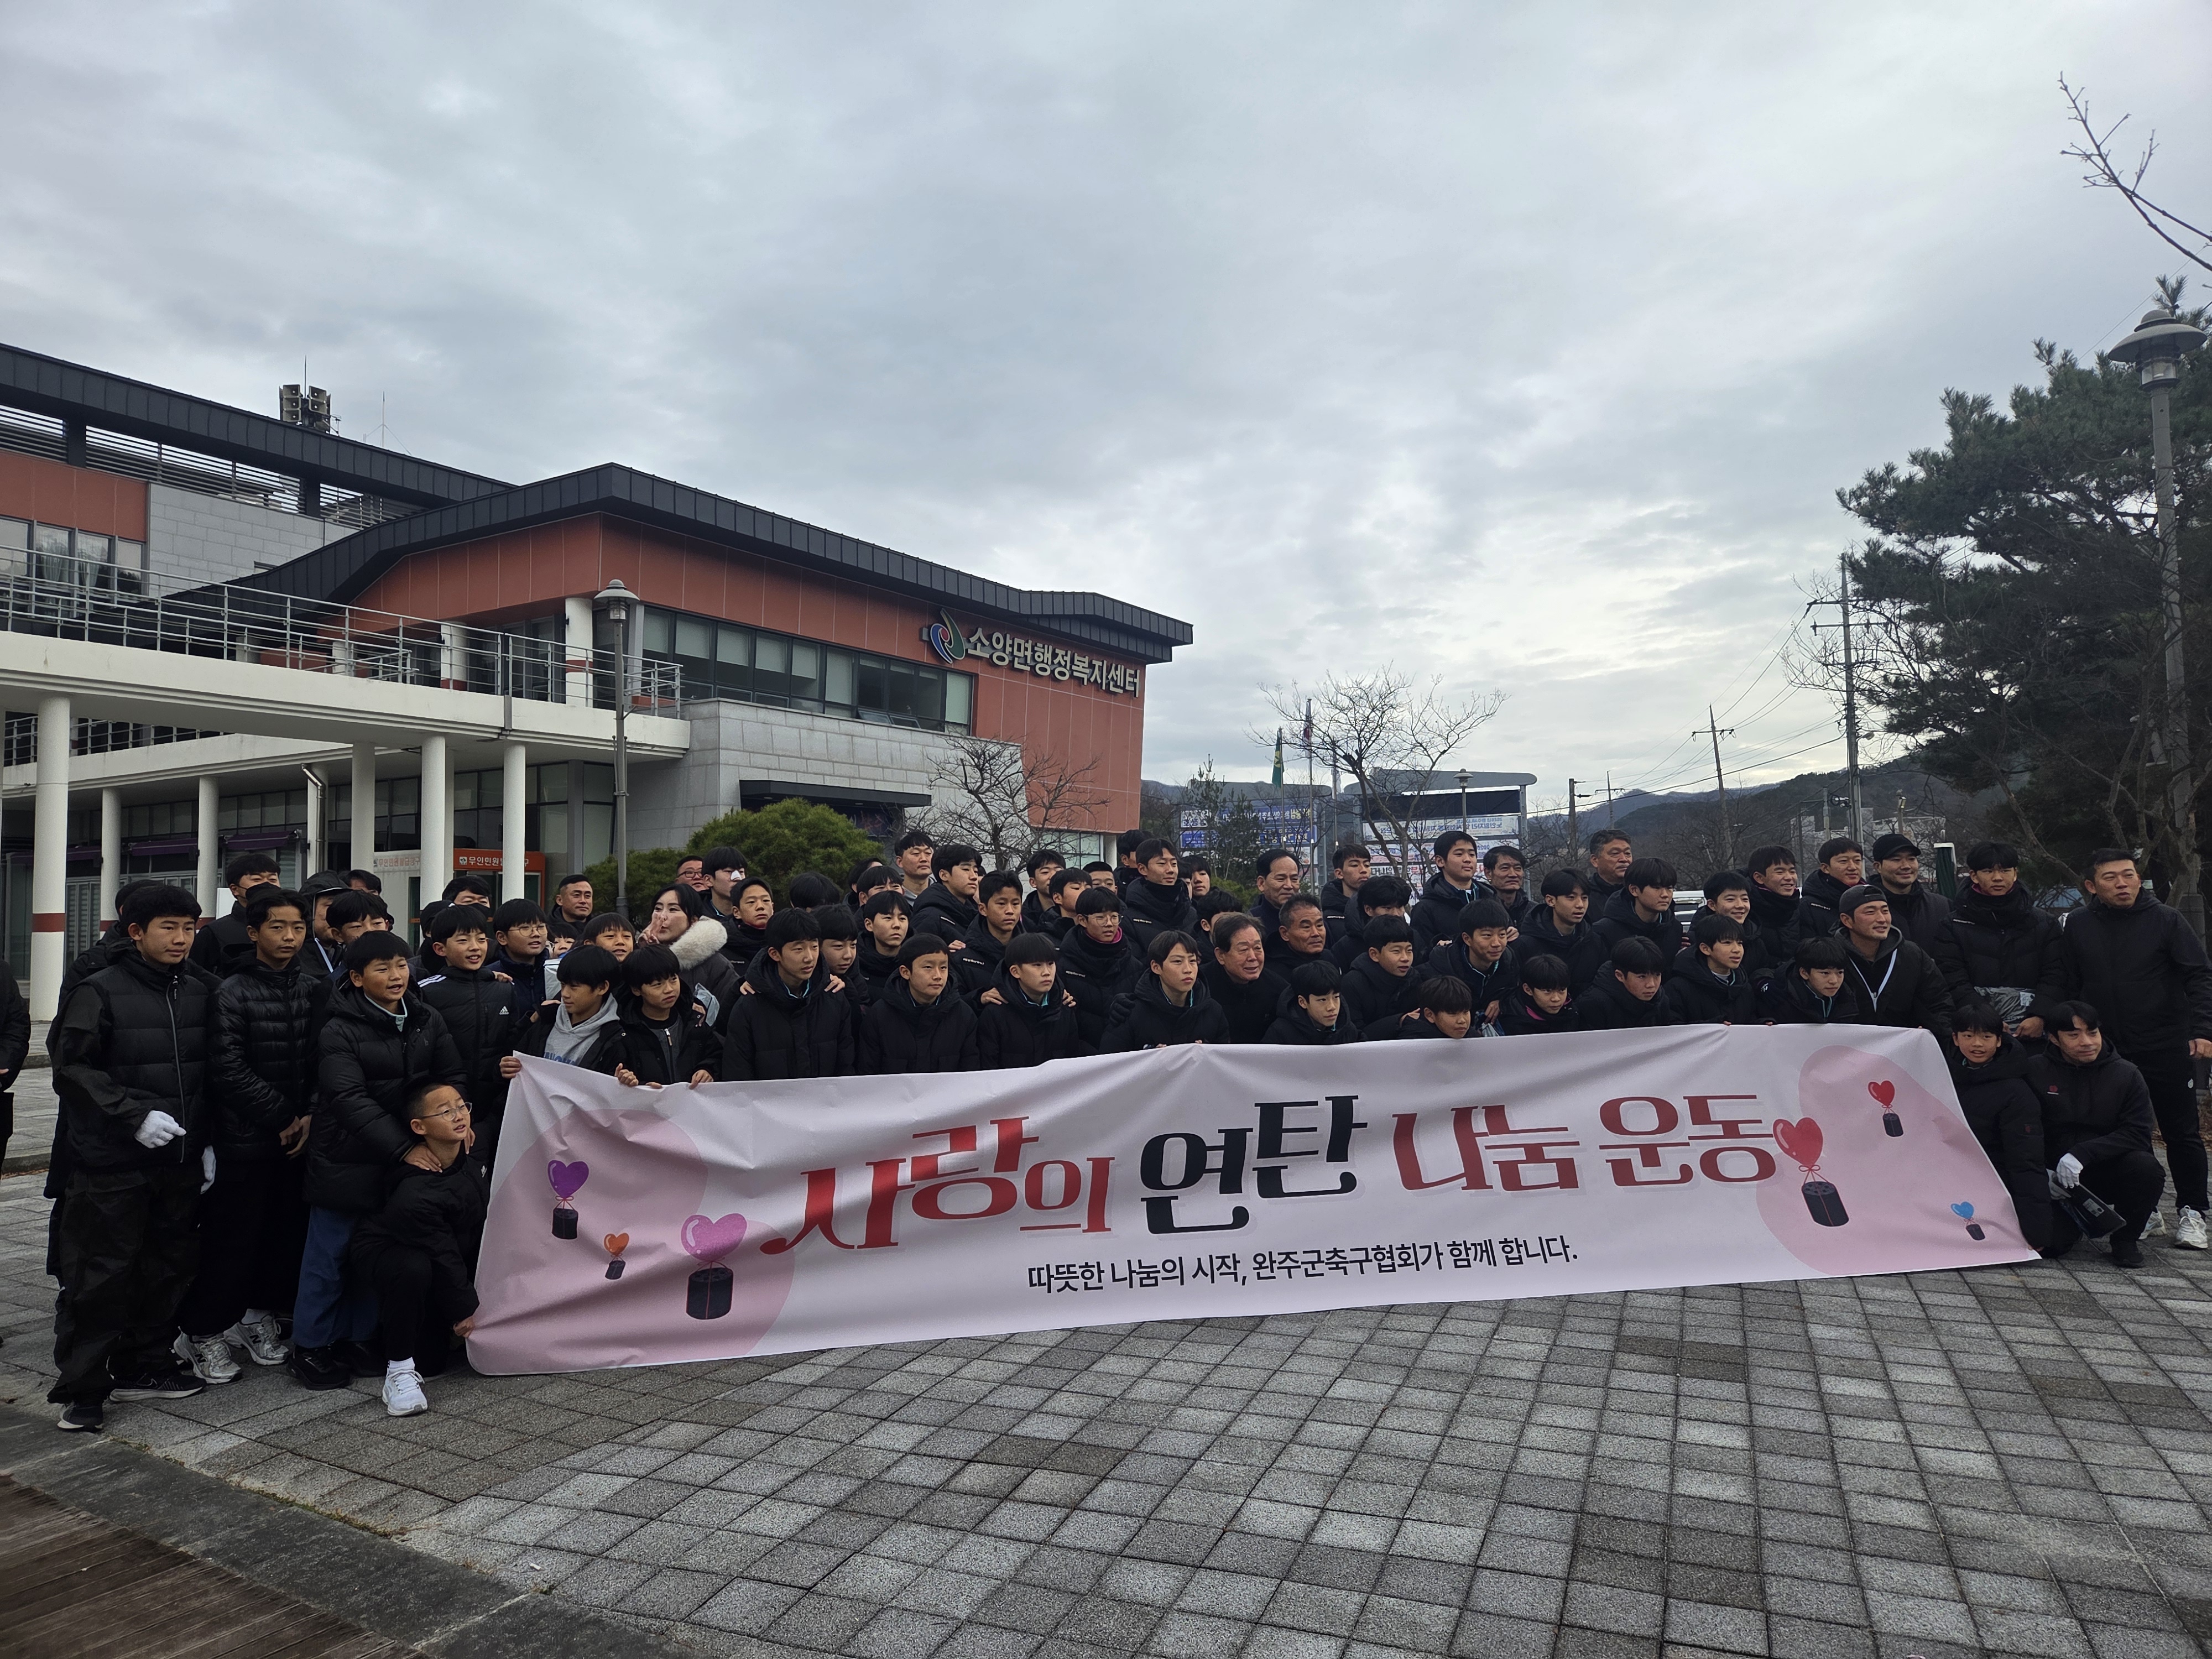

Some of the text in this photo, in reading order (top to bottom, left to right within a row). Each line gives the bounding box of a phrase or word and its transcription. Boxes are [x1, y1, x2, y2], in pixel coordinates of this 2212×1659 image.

[968, 628, 1140, 698] 소양면행정복지센터
[760, 1094, 1776, 1255] 사랑의 연탄 나눔 운동
[1027, 1235, 1578, 1293] 따뜻한 나눔의 시작, 완주군축구협회가 함께 합니다.
